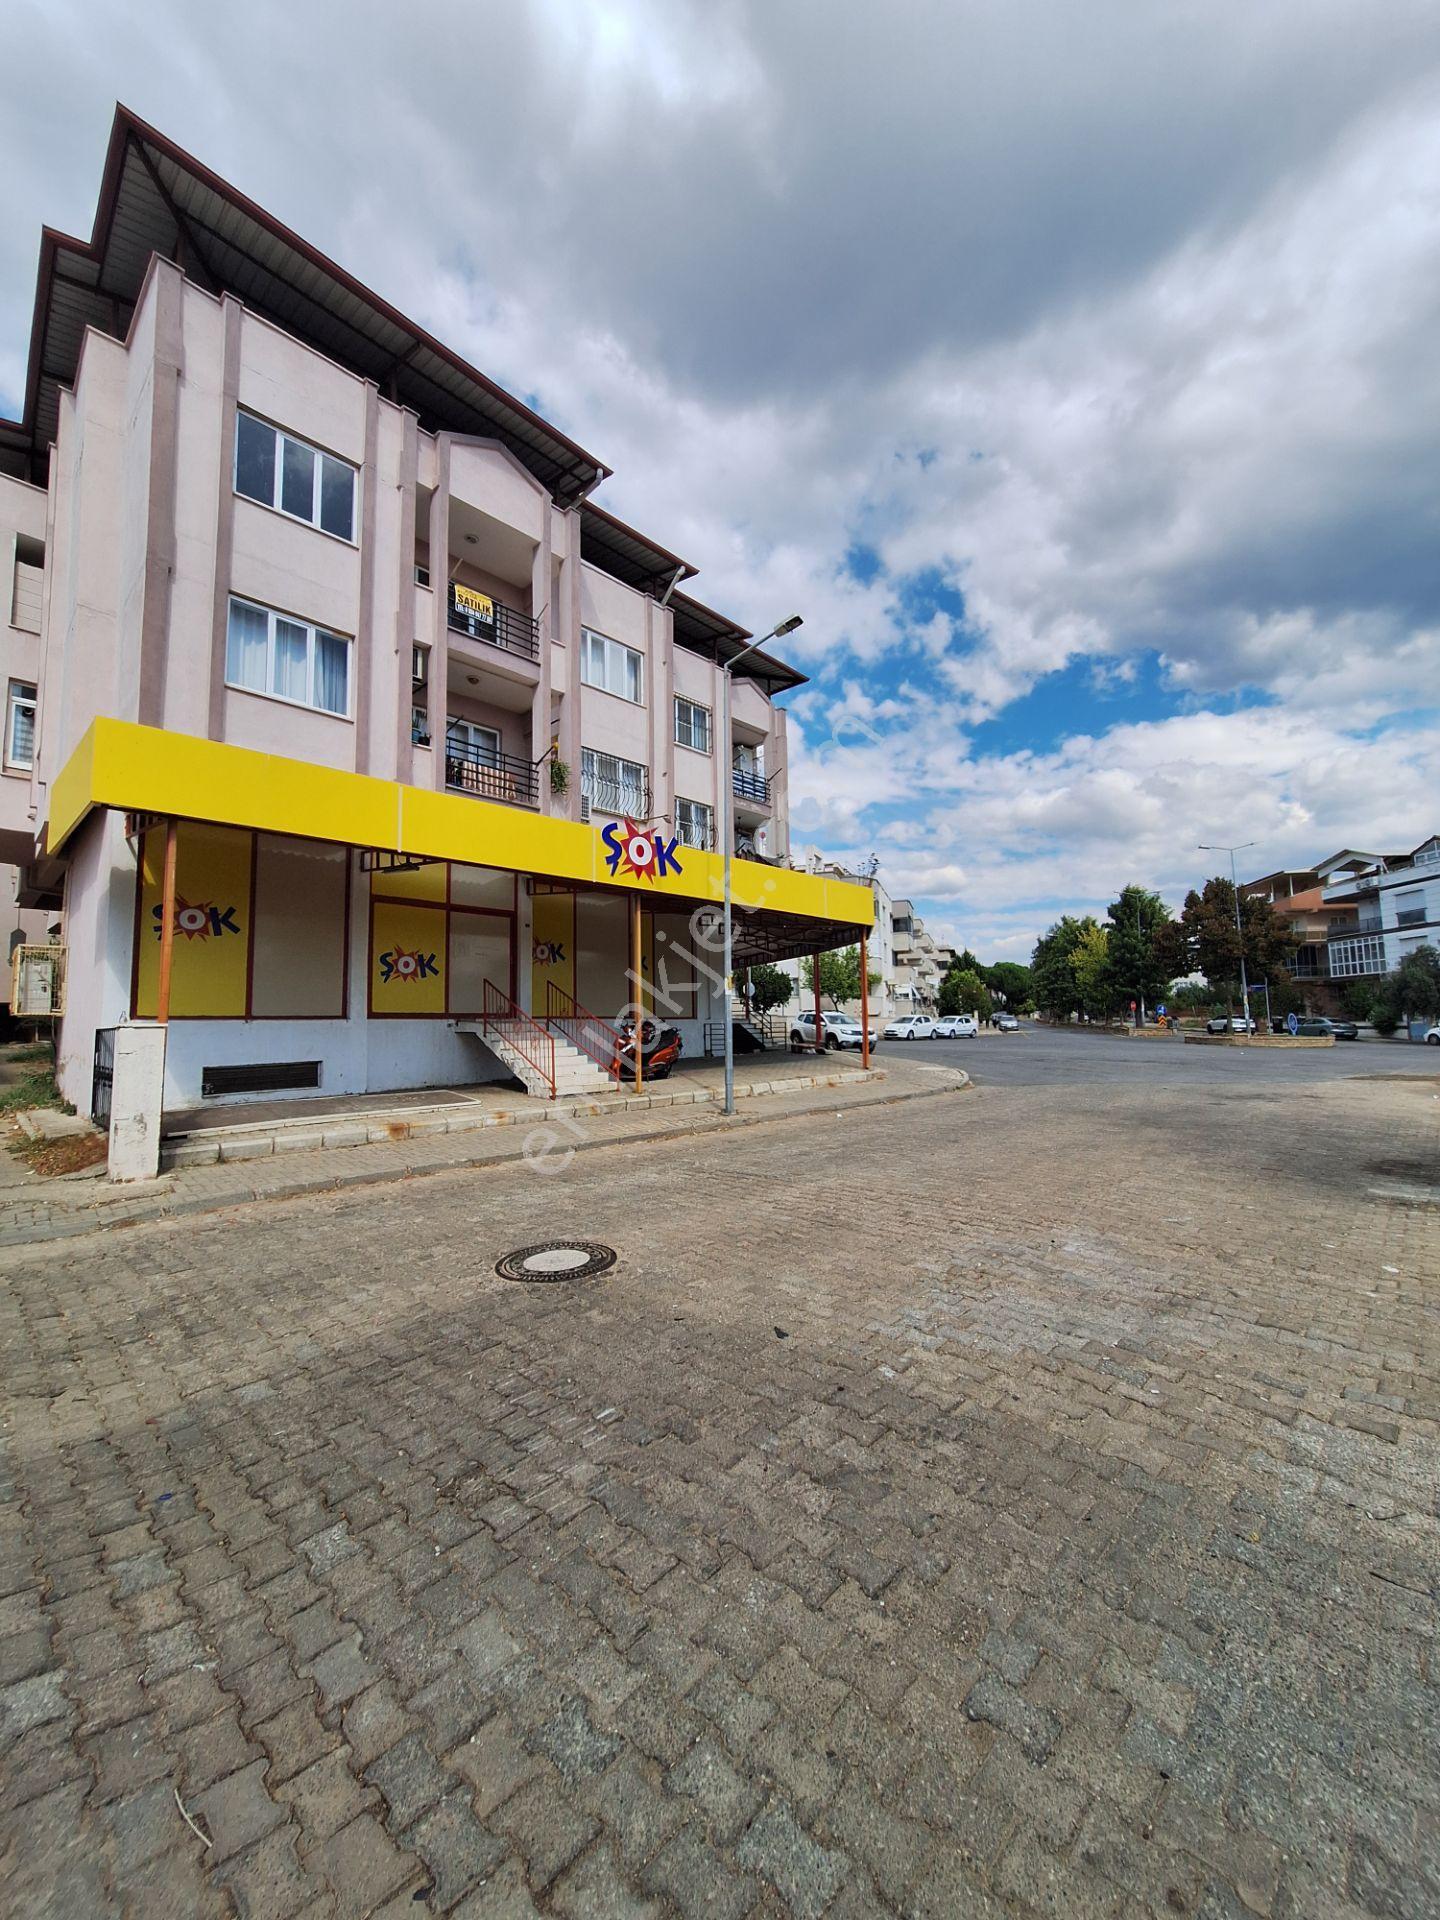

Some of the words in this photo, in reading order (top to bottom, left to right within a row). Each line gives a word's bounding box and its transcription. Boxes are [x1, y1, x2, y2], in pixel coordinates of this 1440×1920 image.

[457, 594, 491, 614] SATILIK
[601, 822, 683, 877] ŞOK
[533, 943, 566, 963] OK
[379, 951, 440, 984] ŞOK
